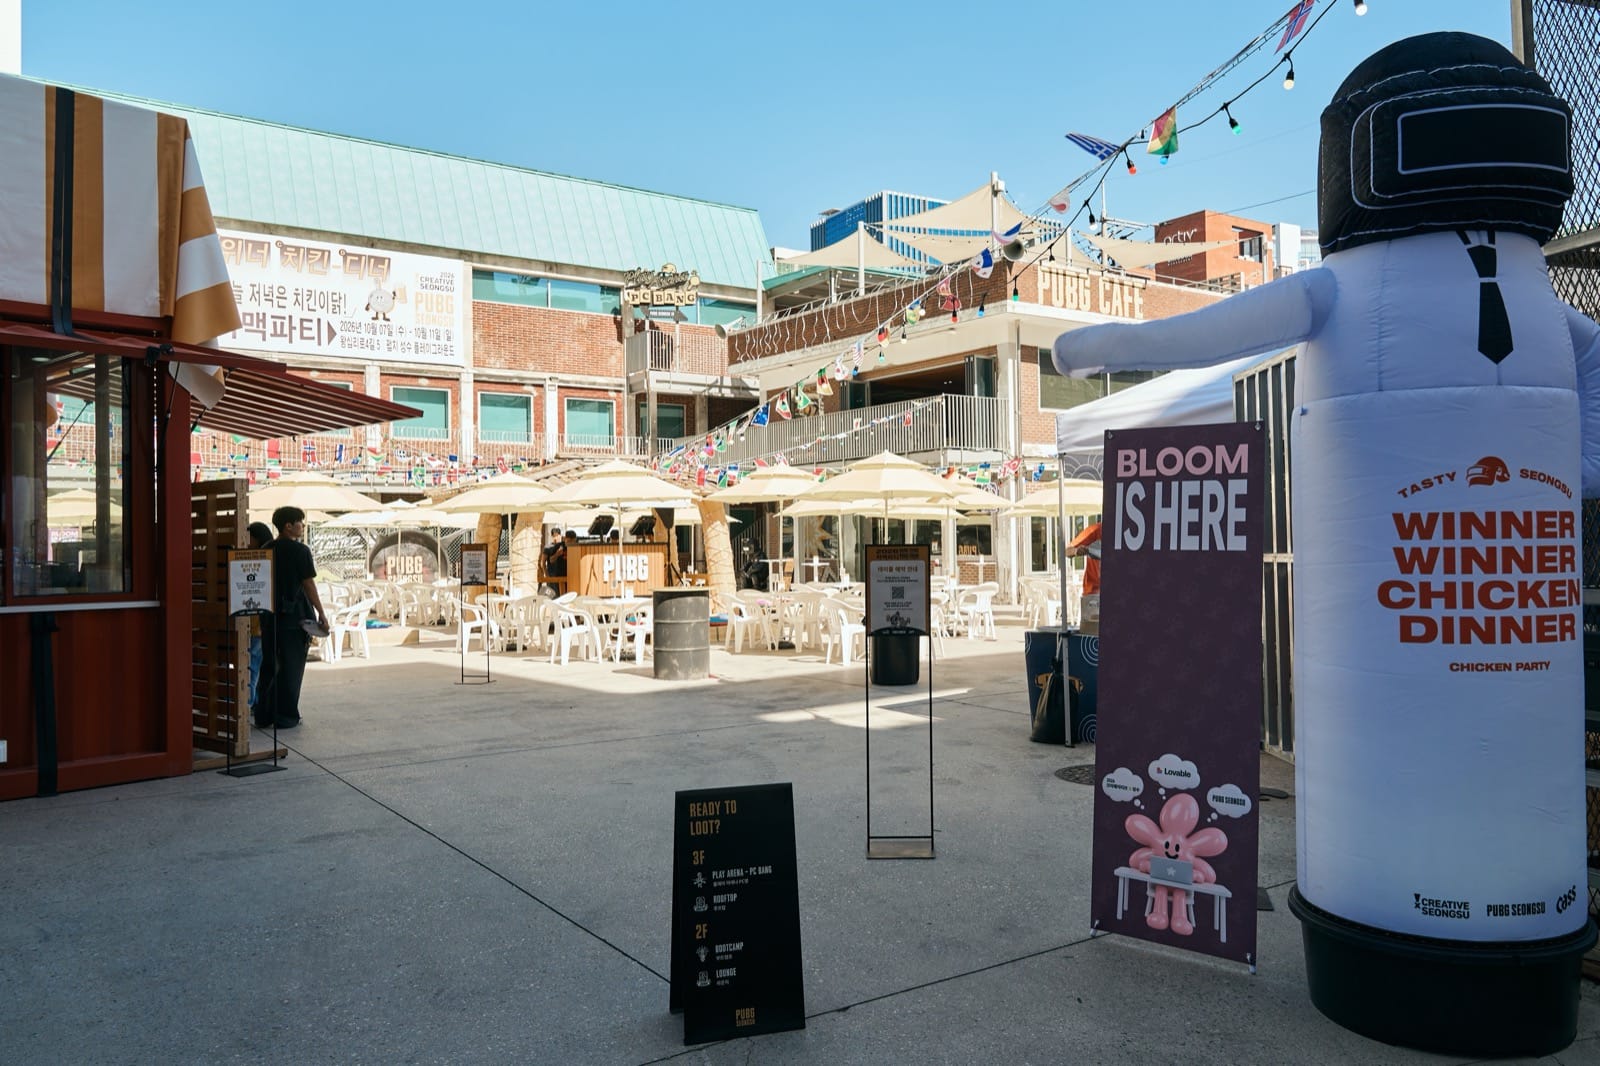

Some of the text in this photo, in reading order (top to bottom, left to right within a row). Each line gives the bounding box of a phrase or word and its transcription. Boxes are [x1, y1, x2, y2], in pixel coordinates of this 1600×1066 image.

[220, 237, 391, 282] 위너 치킨 디너
[420, 276, 455, 285] CREATIVE
[420, 283, 455, 293] SEONGSU
[232, 280, 347, 315] 늘 저녁은 치킨이닭!
[631, 291, 695, 303] PC BANG
[1038, 266, 1144, 320] PUBG CAFE
[415, 291, 454, 314] PUBG
[232, 311, 322, 346] 맥파티
[340, 320, 362, 334] 2026년
[364, 322, 377, 335] 10월
[400, 341, 412, 354] 성수
[1117, 444, 1249, 477] BLOOM
[1397, 468, 1573, 499] TASTY SEONGSU
[1114, 479, 1248, 551] IS HERE
[1392, 511, 1575, 540] WINNER
[387, 556, 423, 575] PUBG
[1392, 545, 1576, 575] WINNER
[1377, 578, 1581, 610] CHICKEN
[1399, 613, 1576, 644] DINNER
[1449, 661, 1550, 672] CHICKEN PARTY
[1164, 767, 1191, 778] Lovable
[689, 799, 737, 818] READY TO
[690, 819, 721, 836] LOOT?
[692, 850, 705, 865] 3F
[712, 870, 726, 880] PLAY
[726, 867, 744, 879] ARENA
[749, 866, 757, 876] PC
[758, 865, 772, 875] BANG
[1421, 898, 1470, 911] CREATIVE
[1555, 885, 1577, 914] Cass
[1421, 907, 1470, 919] SEONGSU
[1486, 902, 1546, 917] PUBG SEONGSU
[695, 924, 708, 940] 2F
[715, 942, 744, 953] BOOTCAMP
[716, 967, 737, 979] LOUNGE
[735, 1008, 755, 1021] PUBG
